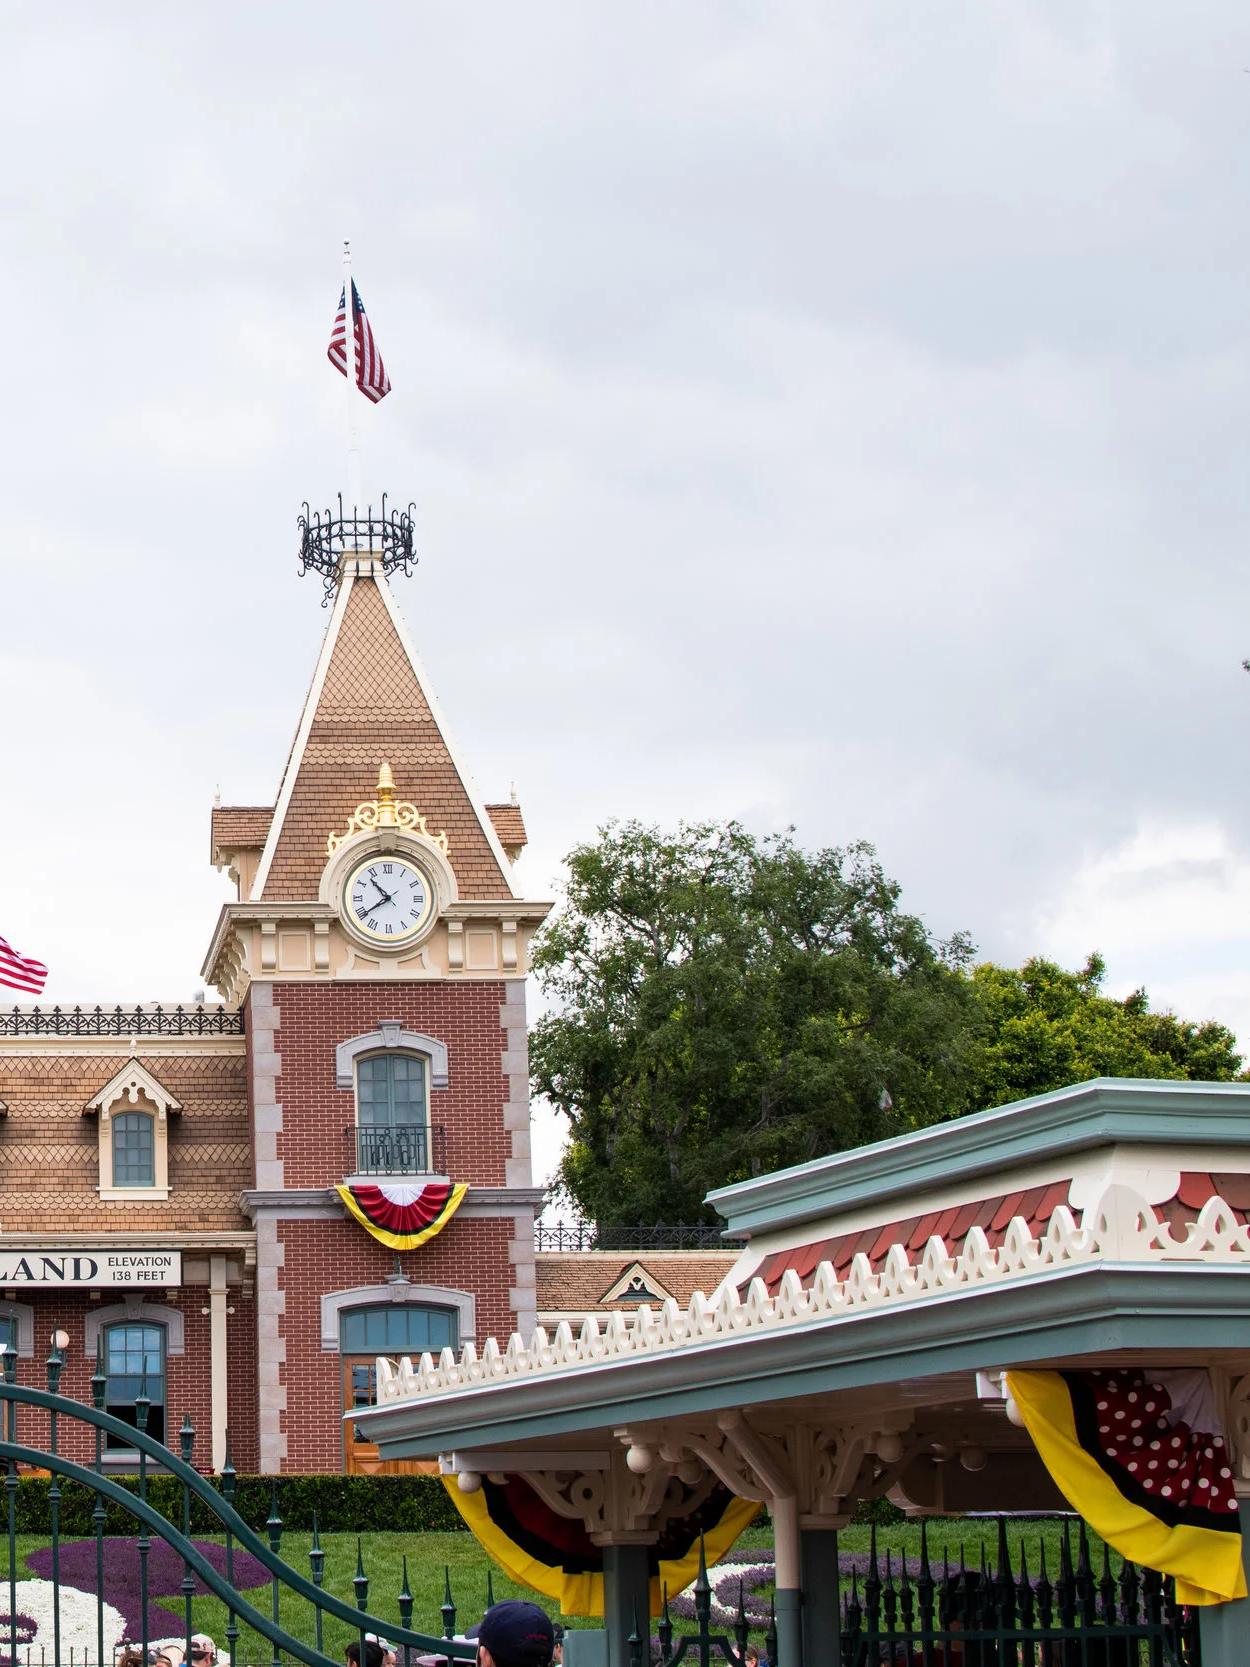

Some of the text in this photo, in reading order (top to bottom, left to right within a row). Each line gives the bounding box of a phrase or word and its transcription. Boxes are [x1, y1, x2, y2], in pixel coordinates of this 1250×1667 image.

[368, 867, 377, 878] XI
[383, 864, 392, 874] XII
[400, 869, 406, 877] I
[357, 880, 366, 888] X
[409, 880, 419, 888] II
[414, 895, 423, 903] III
[367, 919, 378, 930] VII
[385, 924, 392, 933] VI
[401, 921, 407, 930] V
[108, 1257, 171, 1266] ELEVATION
[112, 1271, 166, 1280] 138 FEET
